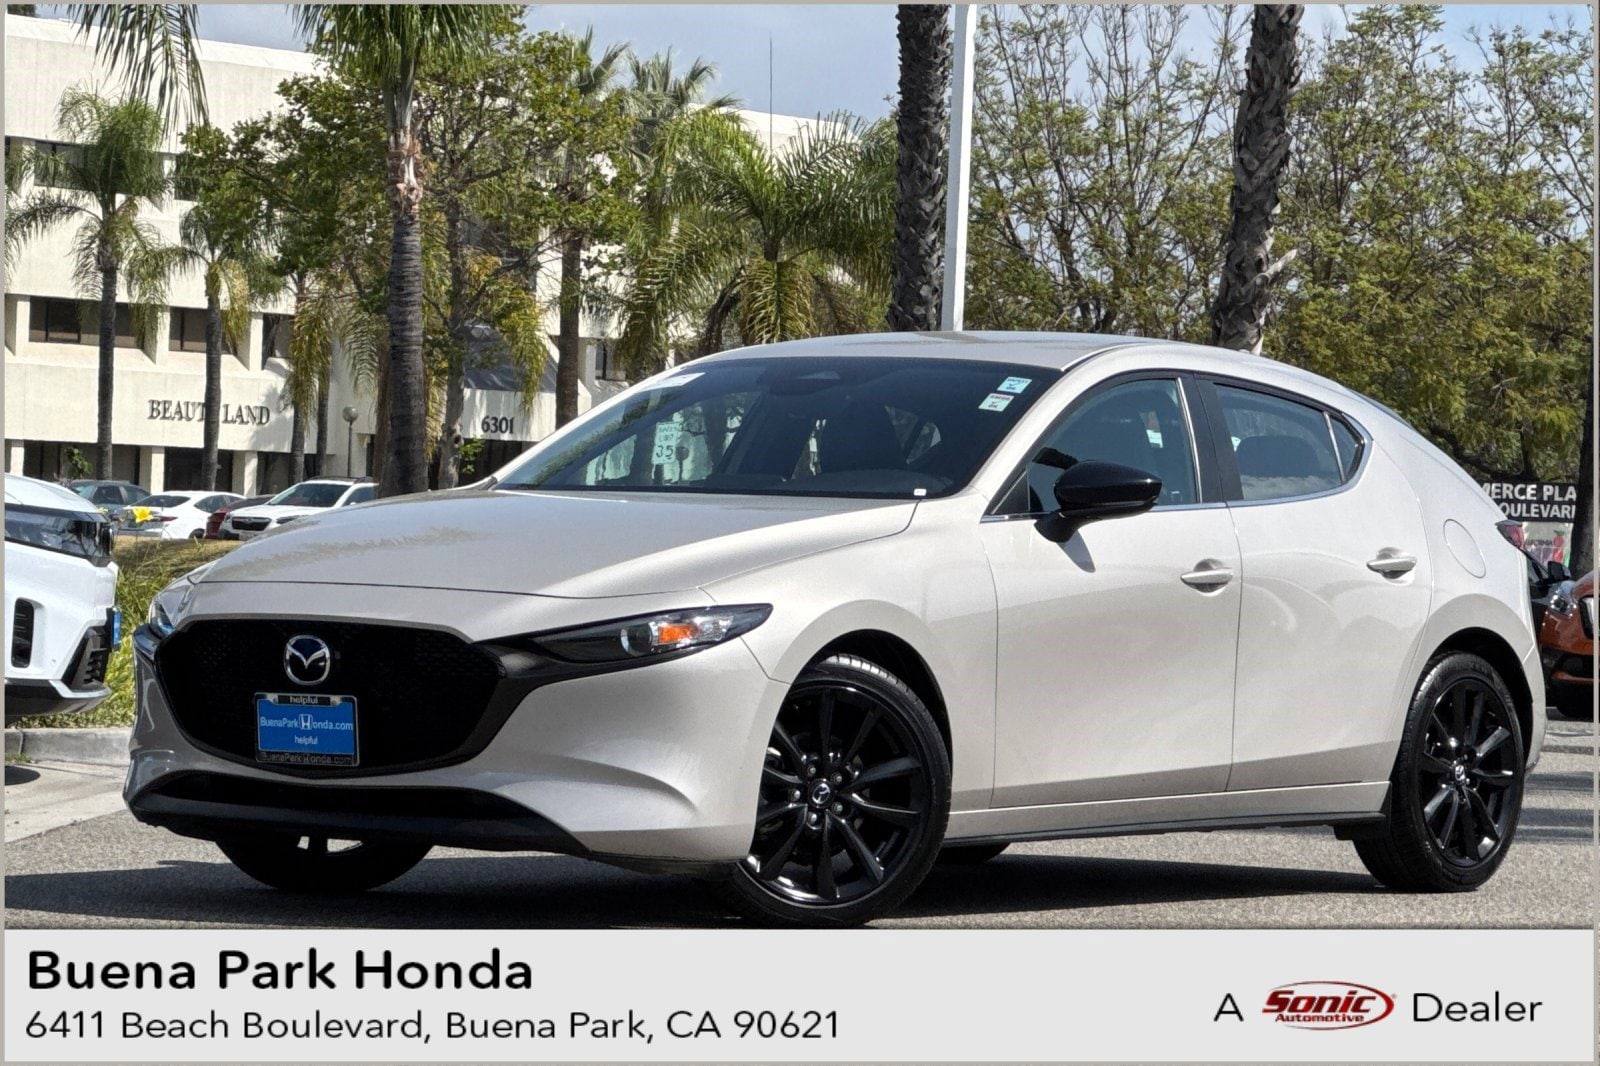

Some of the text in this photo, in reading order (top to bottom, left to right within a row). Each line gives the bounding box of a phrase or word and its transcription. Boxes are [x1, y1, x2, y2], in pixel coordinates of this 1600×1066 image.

[147, 399, 271, 425] BEAUTLAND
[481, 414, 515, 434] 6301
[655, 445, 674, 460] 35
[290, 695, 318, 705] helpful
[294, 735, 318, 746] helpful
